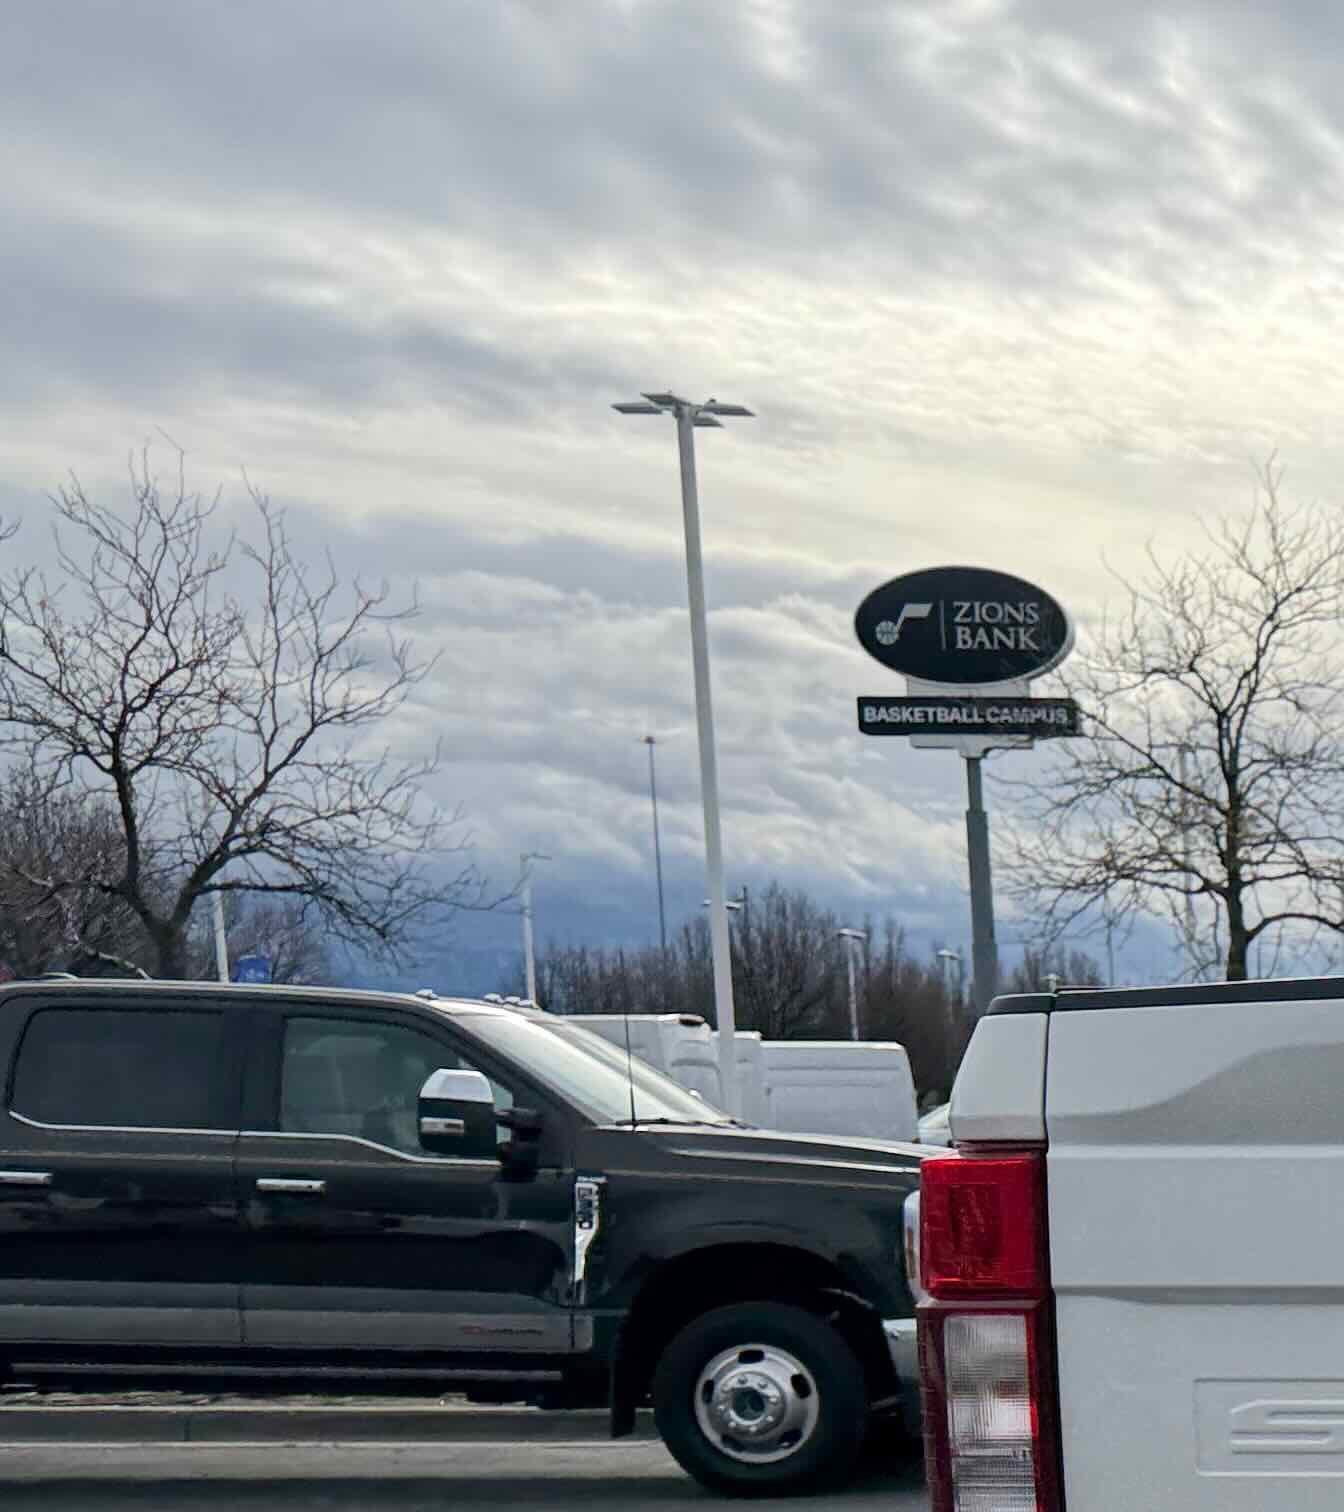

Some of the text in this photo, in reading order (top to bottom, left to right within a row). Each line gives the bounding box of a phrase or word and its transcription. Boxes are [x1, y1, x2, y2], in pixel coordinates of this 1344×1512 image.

[953, 601, 1040, 624] ZIONS
[955, 626, 1040, 651] BANK
[863, 706, 1068, 725] BASKETBALL CAMPUS
